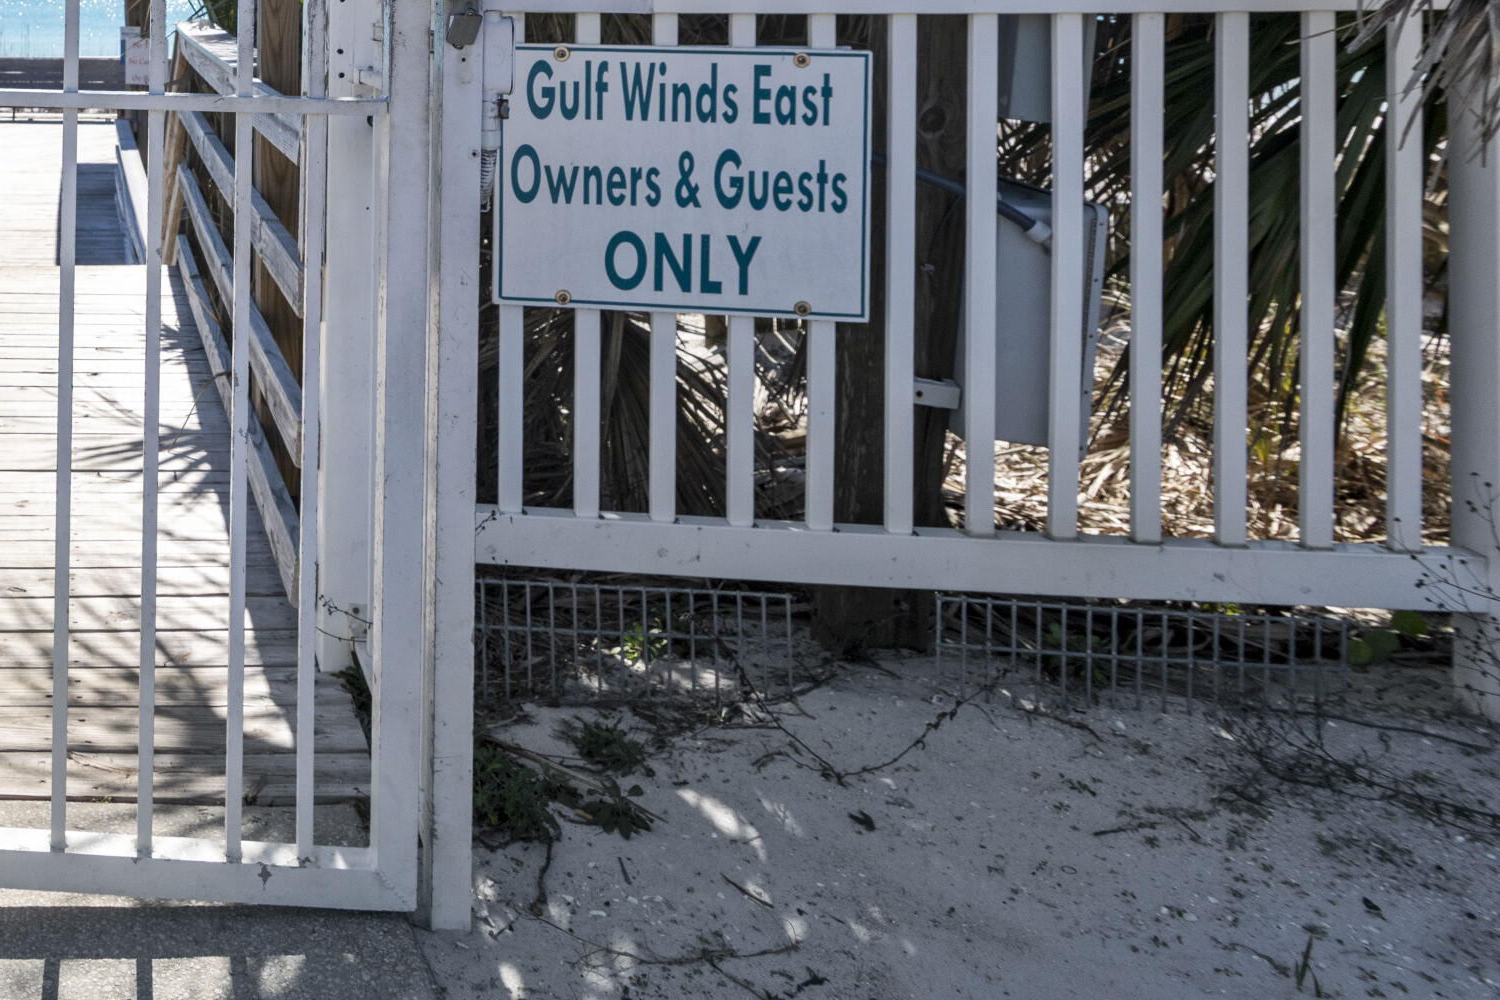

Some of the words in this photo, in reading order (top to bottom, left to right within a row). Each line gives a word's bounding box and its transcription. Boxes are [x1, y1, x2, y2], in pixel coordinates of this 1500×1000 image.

[526, 59, 609, 120] Gulf
[620, 61, 739, 124] Winds
[752, 63, 834, 126] East
[510, 143, 662, 208] Owners
[674, 150, 702, 209] &
[713, 148, 849, 214] Guests
[604, 230, 763, 296] ONLY
